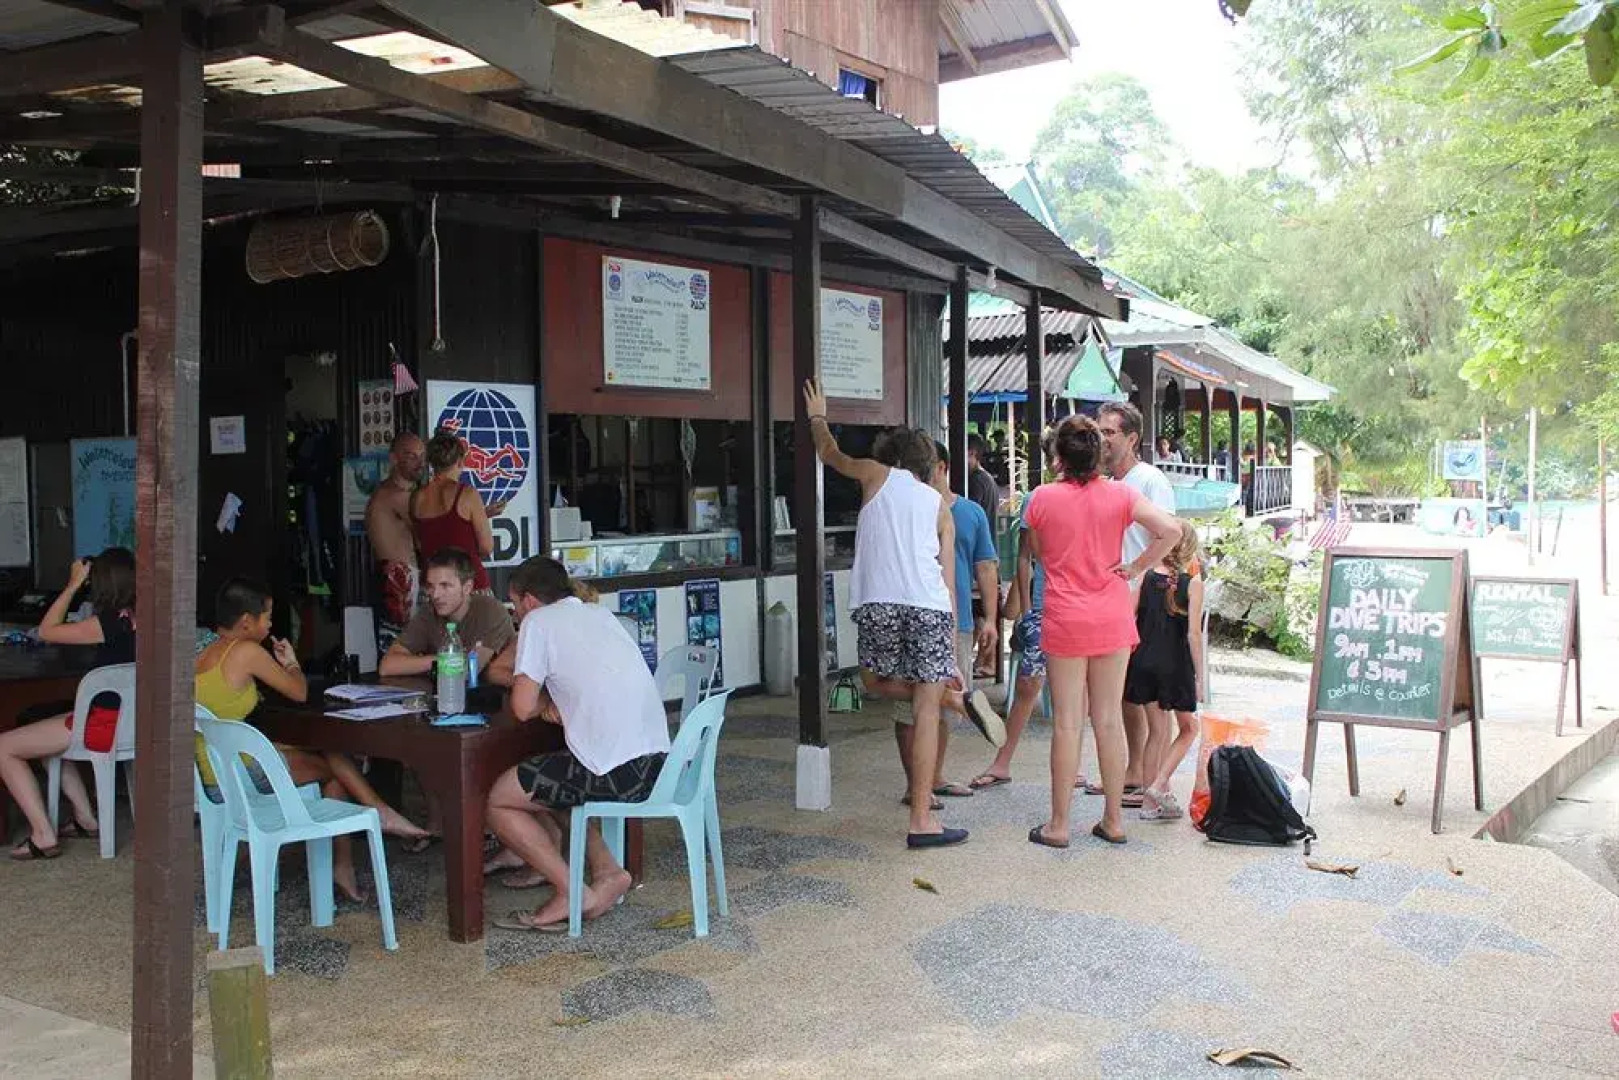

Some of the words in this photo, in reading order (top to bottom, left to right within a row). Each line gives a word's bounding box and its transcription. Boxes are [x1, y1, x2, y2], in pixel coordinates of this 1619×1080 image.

[1350, 588, 1419, 611] DAILY
[1329, 606, 1380, 631] DIVE
[1381, 611, 1451, 637] TRIPS
